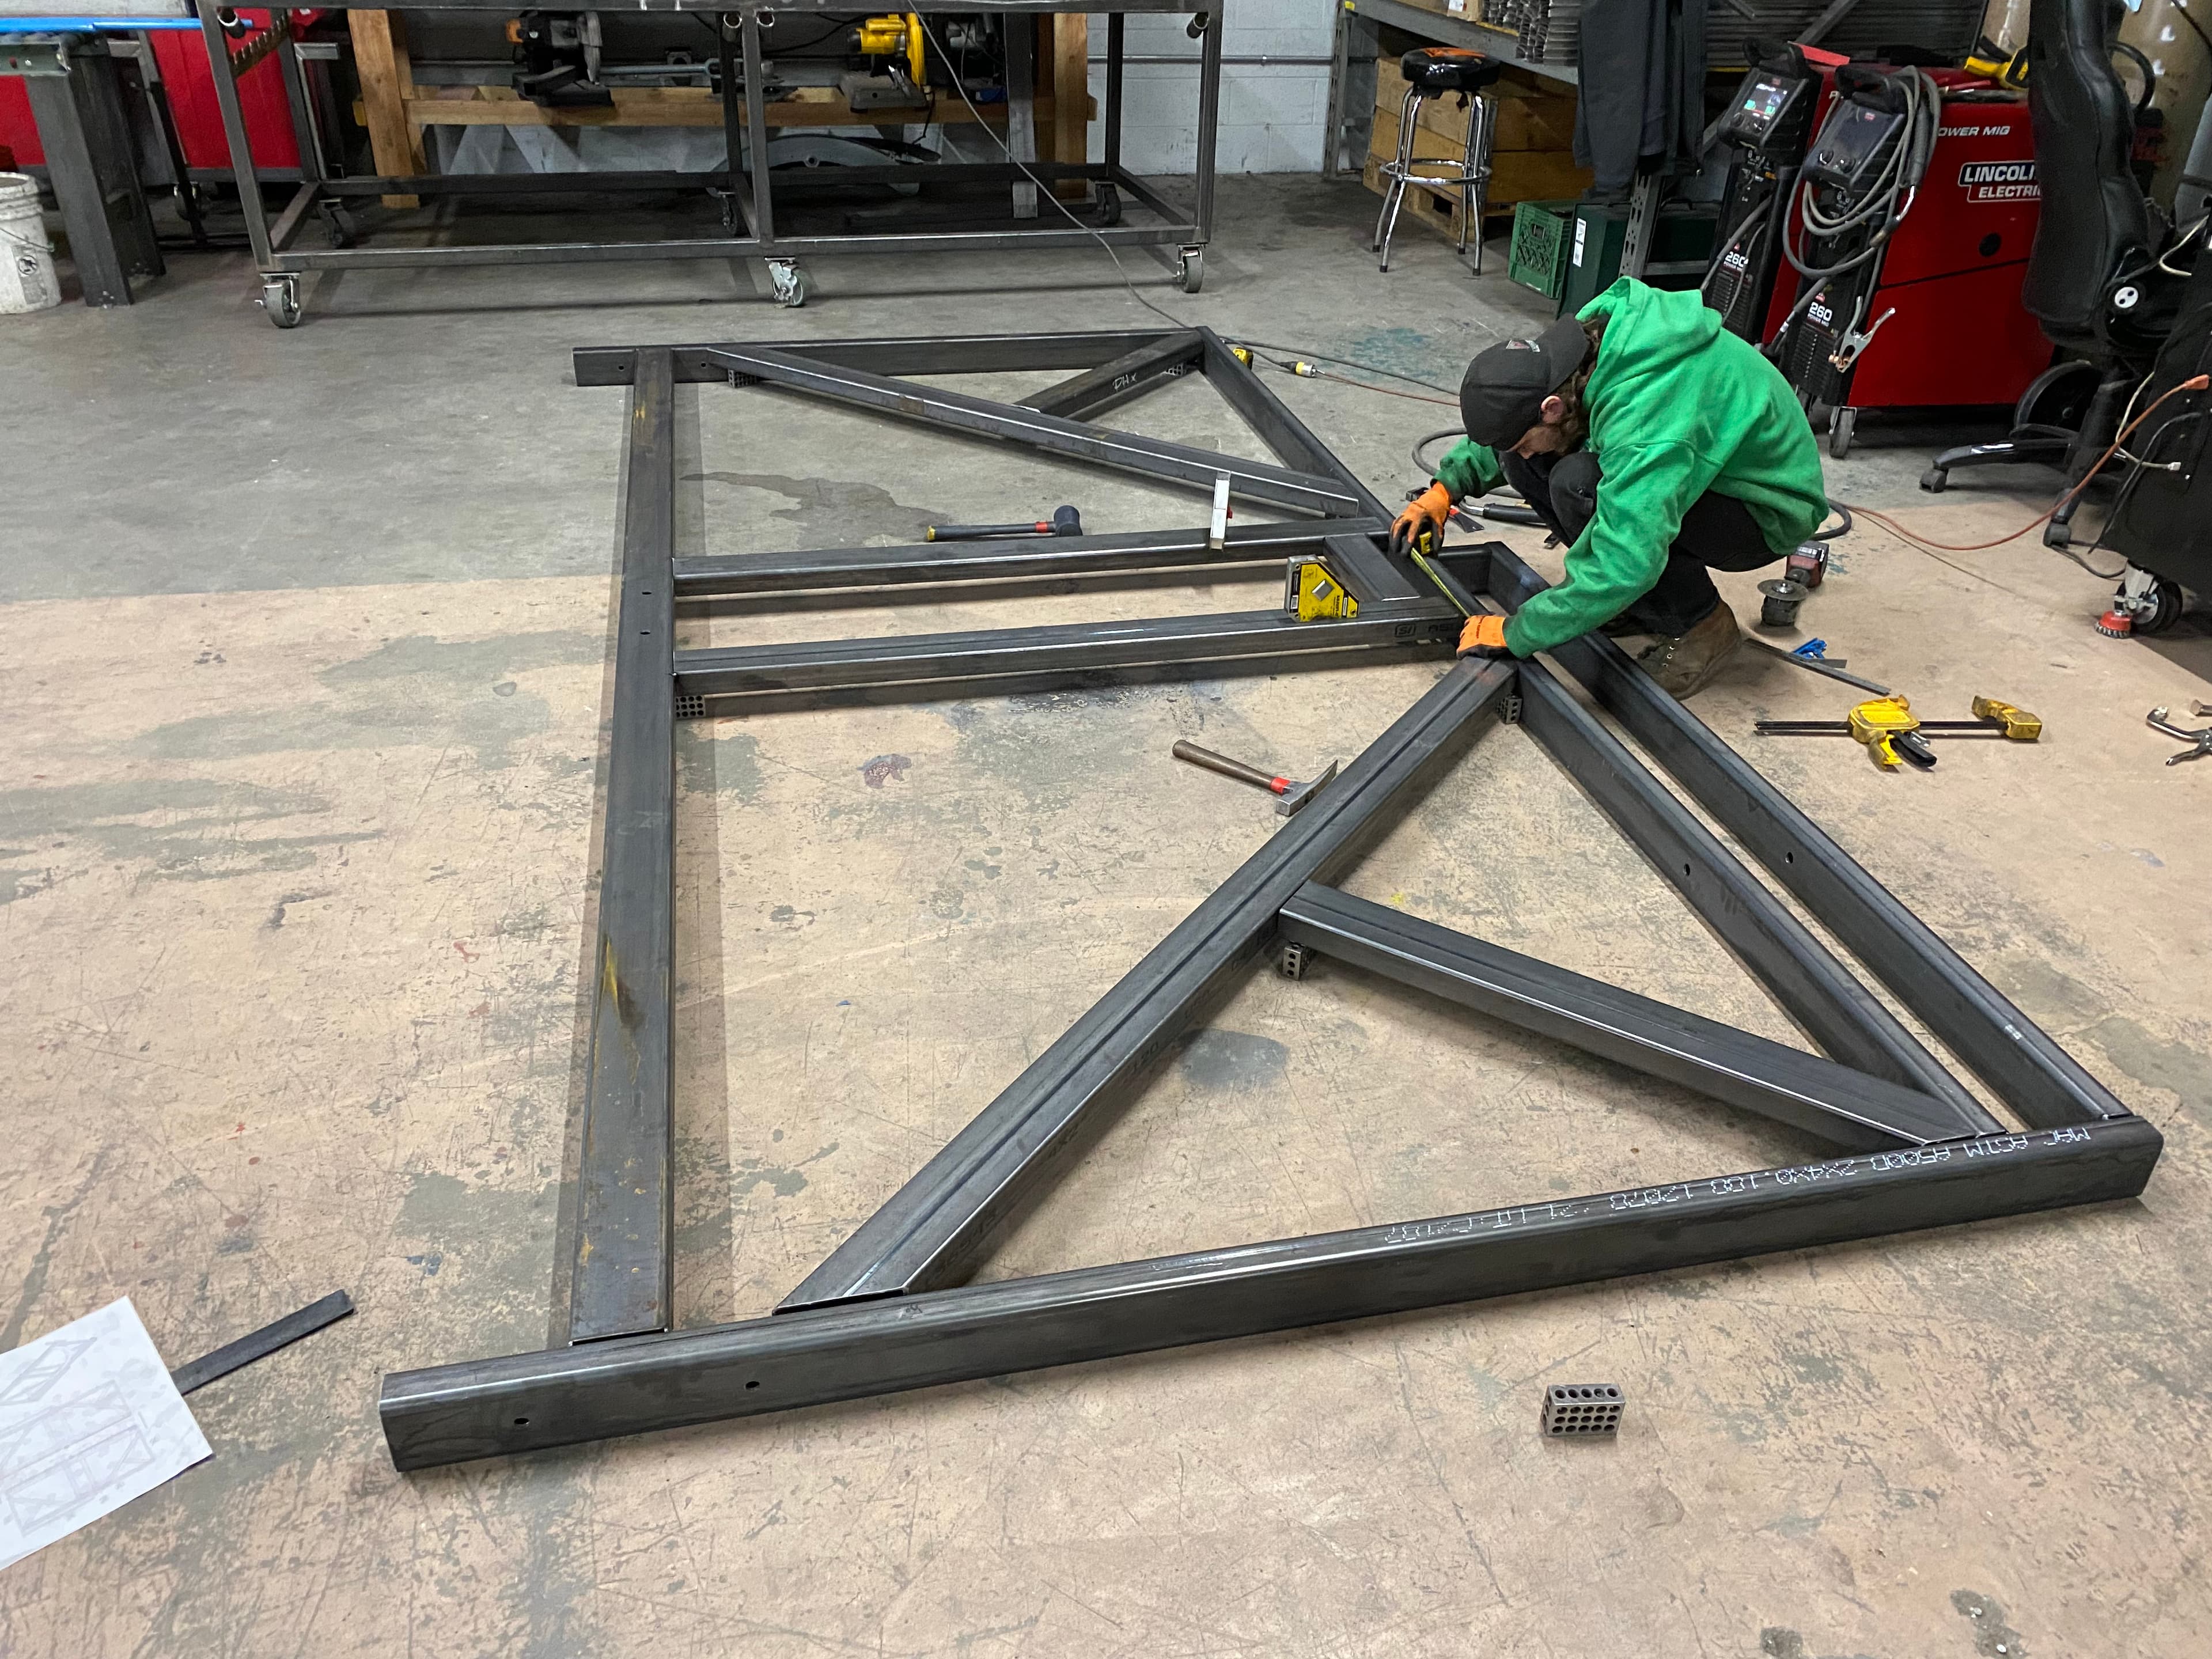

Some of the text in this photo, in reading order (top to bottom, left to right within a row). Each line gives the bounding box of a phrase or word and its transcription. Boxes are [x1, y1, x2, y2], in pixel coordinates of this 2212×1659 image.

[1938, 125, 2011, 137] OWER MIG
[1979, 185, 2041, 199] ELECTRI
[1809, 301, 1832, 321] 260
[1963, 1135, 2029, 1157] ASTM
